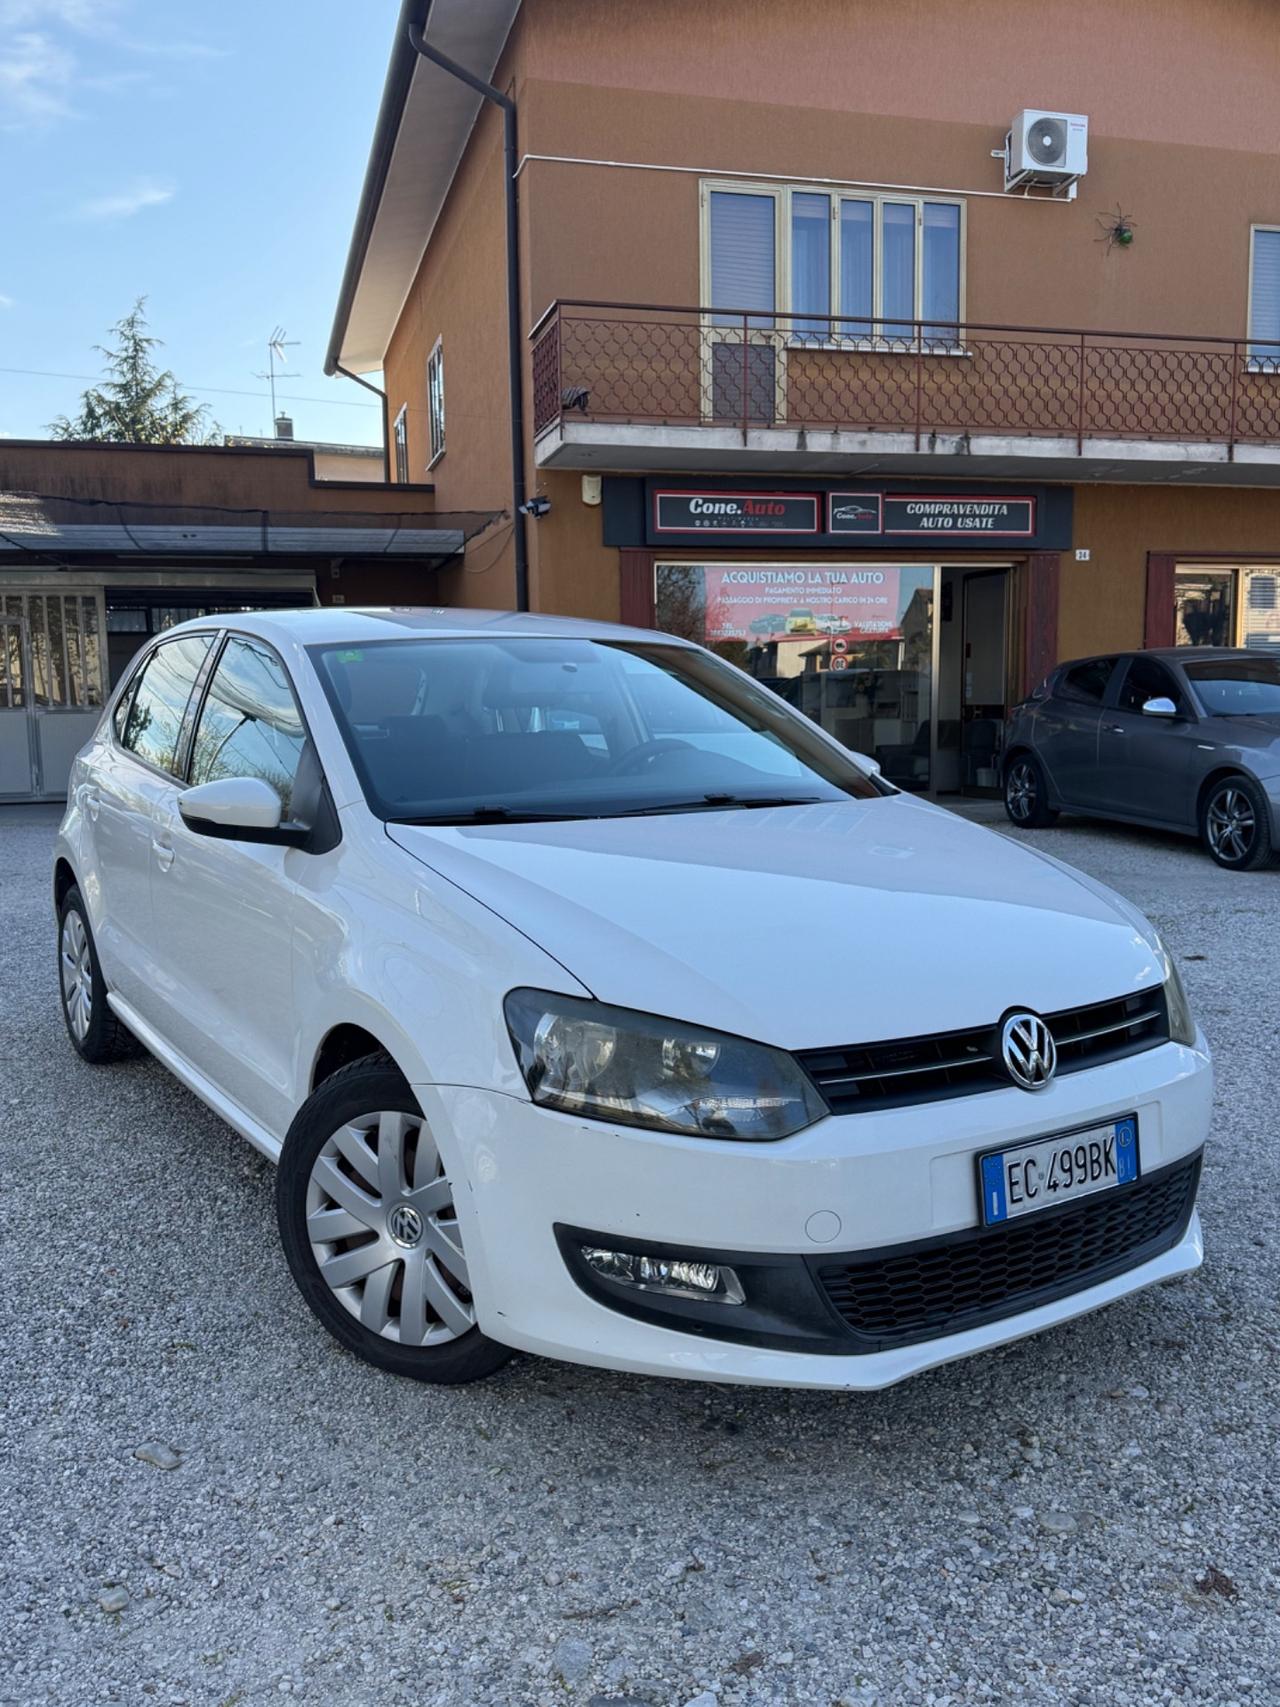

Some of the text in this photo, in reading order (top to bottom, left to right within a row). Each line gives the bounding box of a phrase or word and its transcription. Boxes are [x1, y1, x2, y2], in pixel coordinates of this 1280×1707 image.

[689, 498, 785, 515] Cone.Auto
[906, 503, 1008, 516] COMPRAVENDITA
[919, 517, 995, 528] AUTO USATE
[721, 571, 884, 583] ACQUISTIAMO LA TUA AUTO
